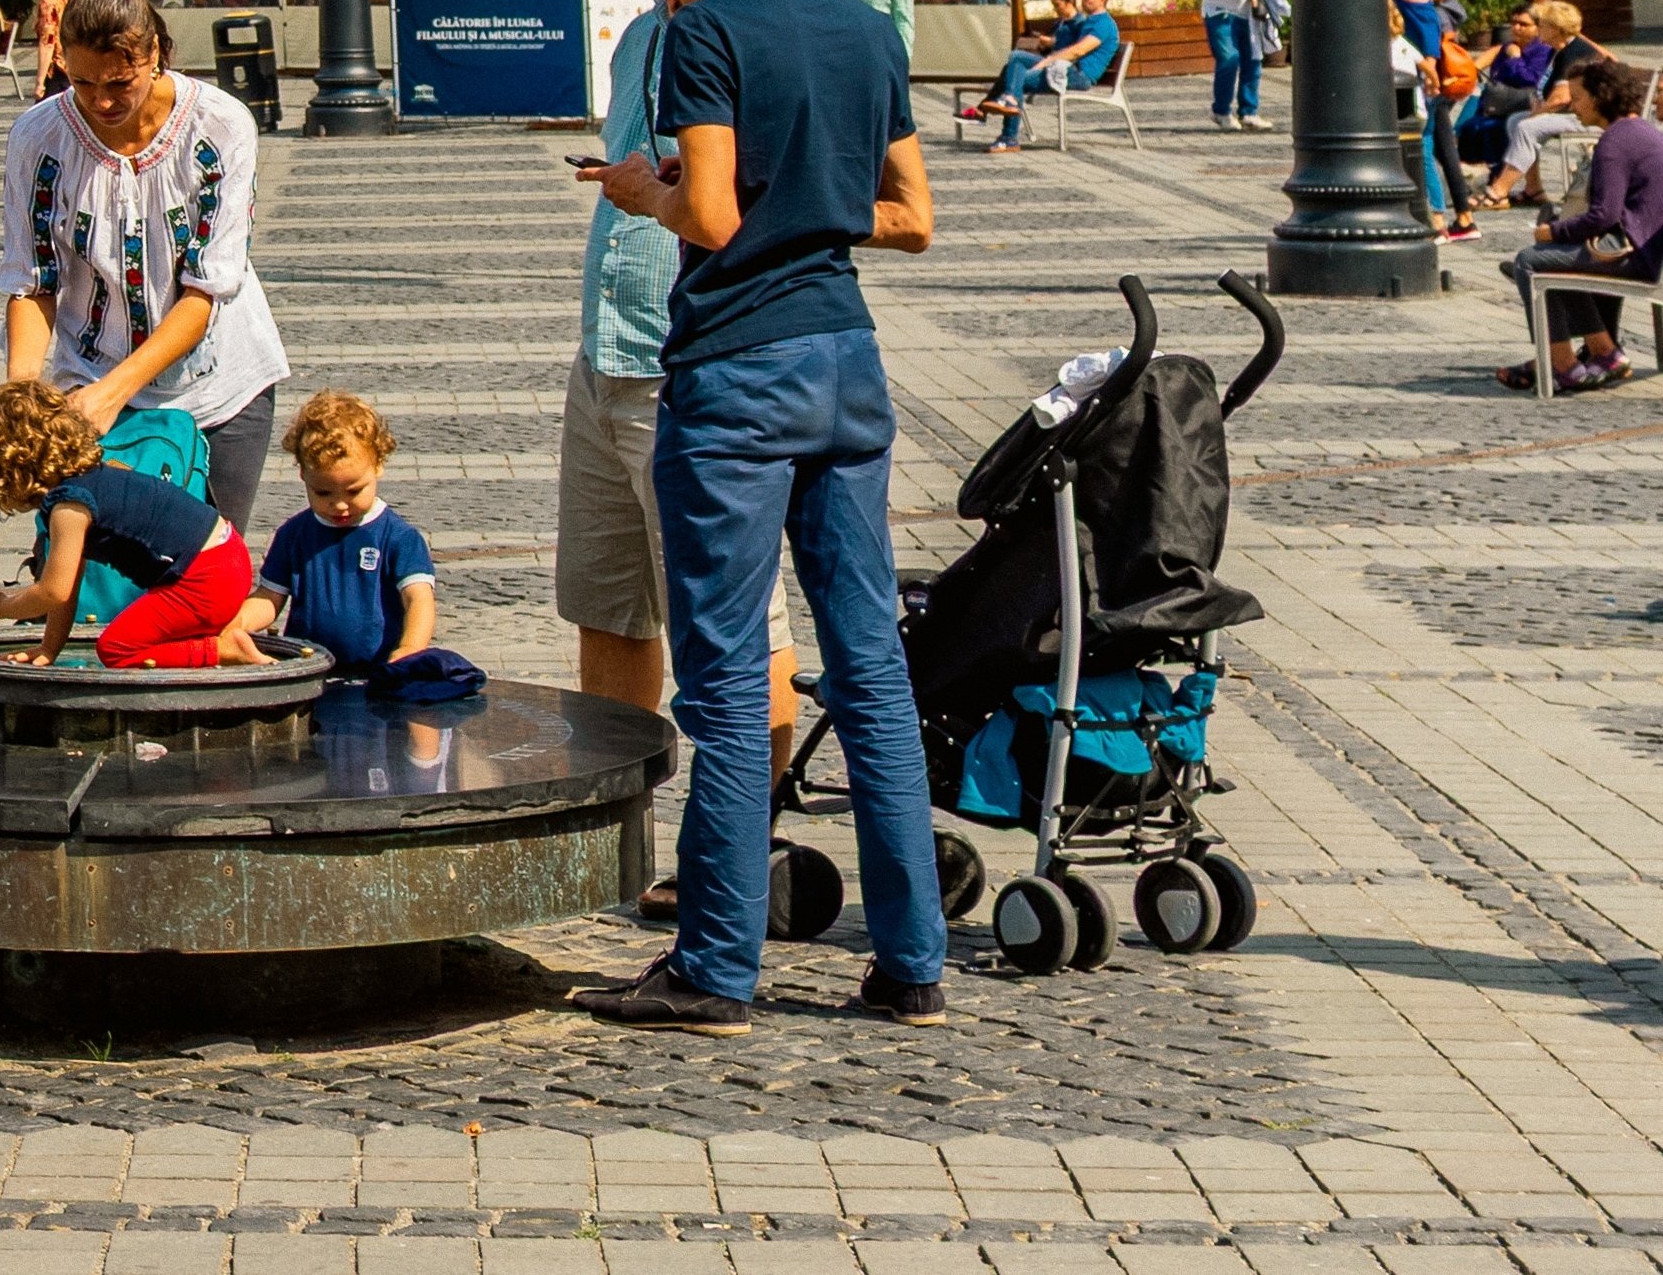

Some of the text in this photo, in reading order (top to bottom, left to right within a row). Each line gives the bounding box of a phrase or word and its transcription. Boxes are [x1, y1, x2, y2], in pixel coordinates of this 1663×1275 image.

[433, 16, 544, 28] CĂLĂTORIE ÎN LUMEA
[416, 30, 466, 41] FILMULUI
[479, 30, 487, 40] A
[489, 30, 565, 41] MUSICAL-ULUI
